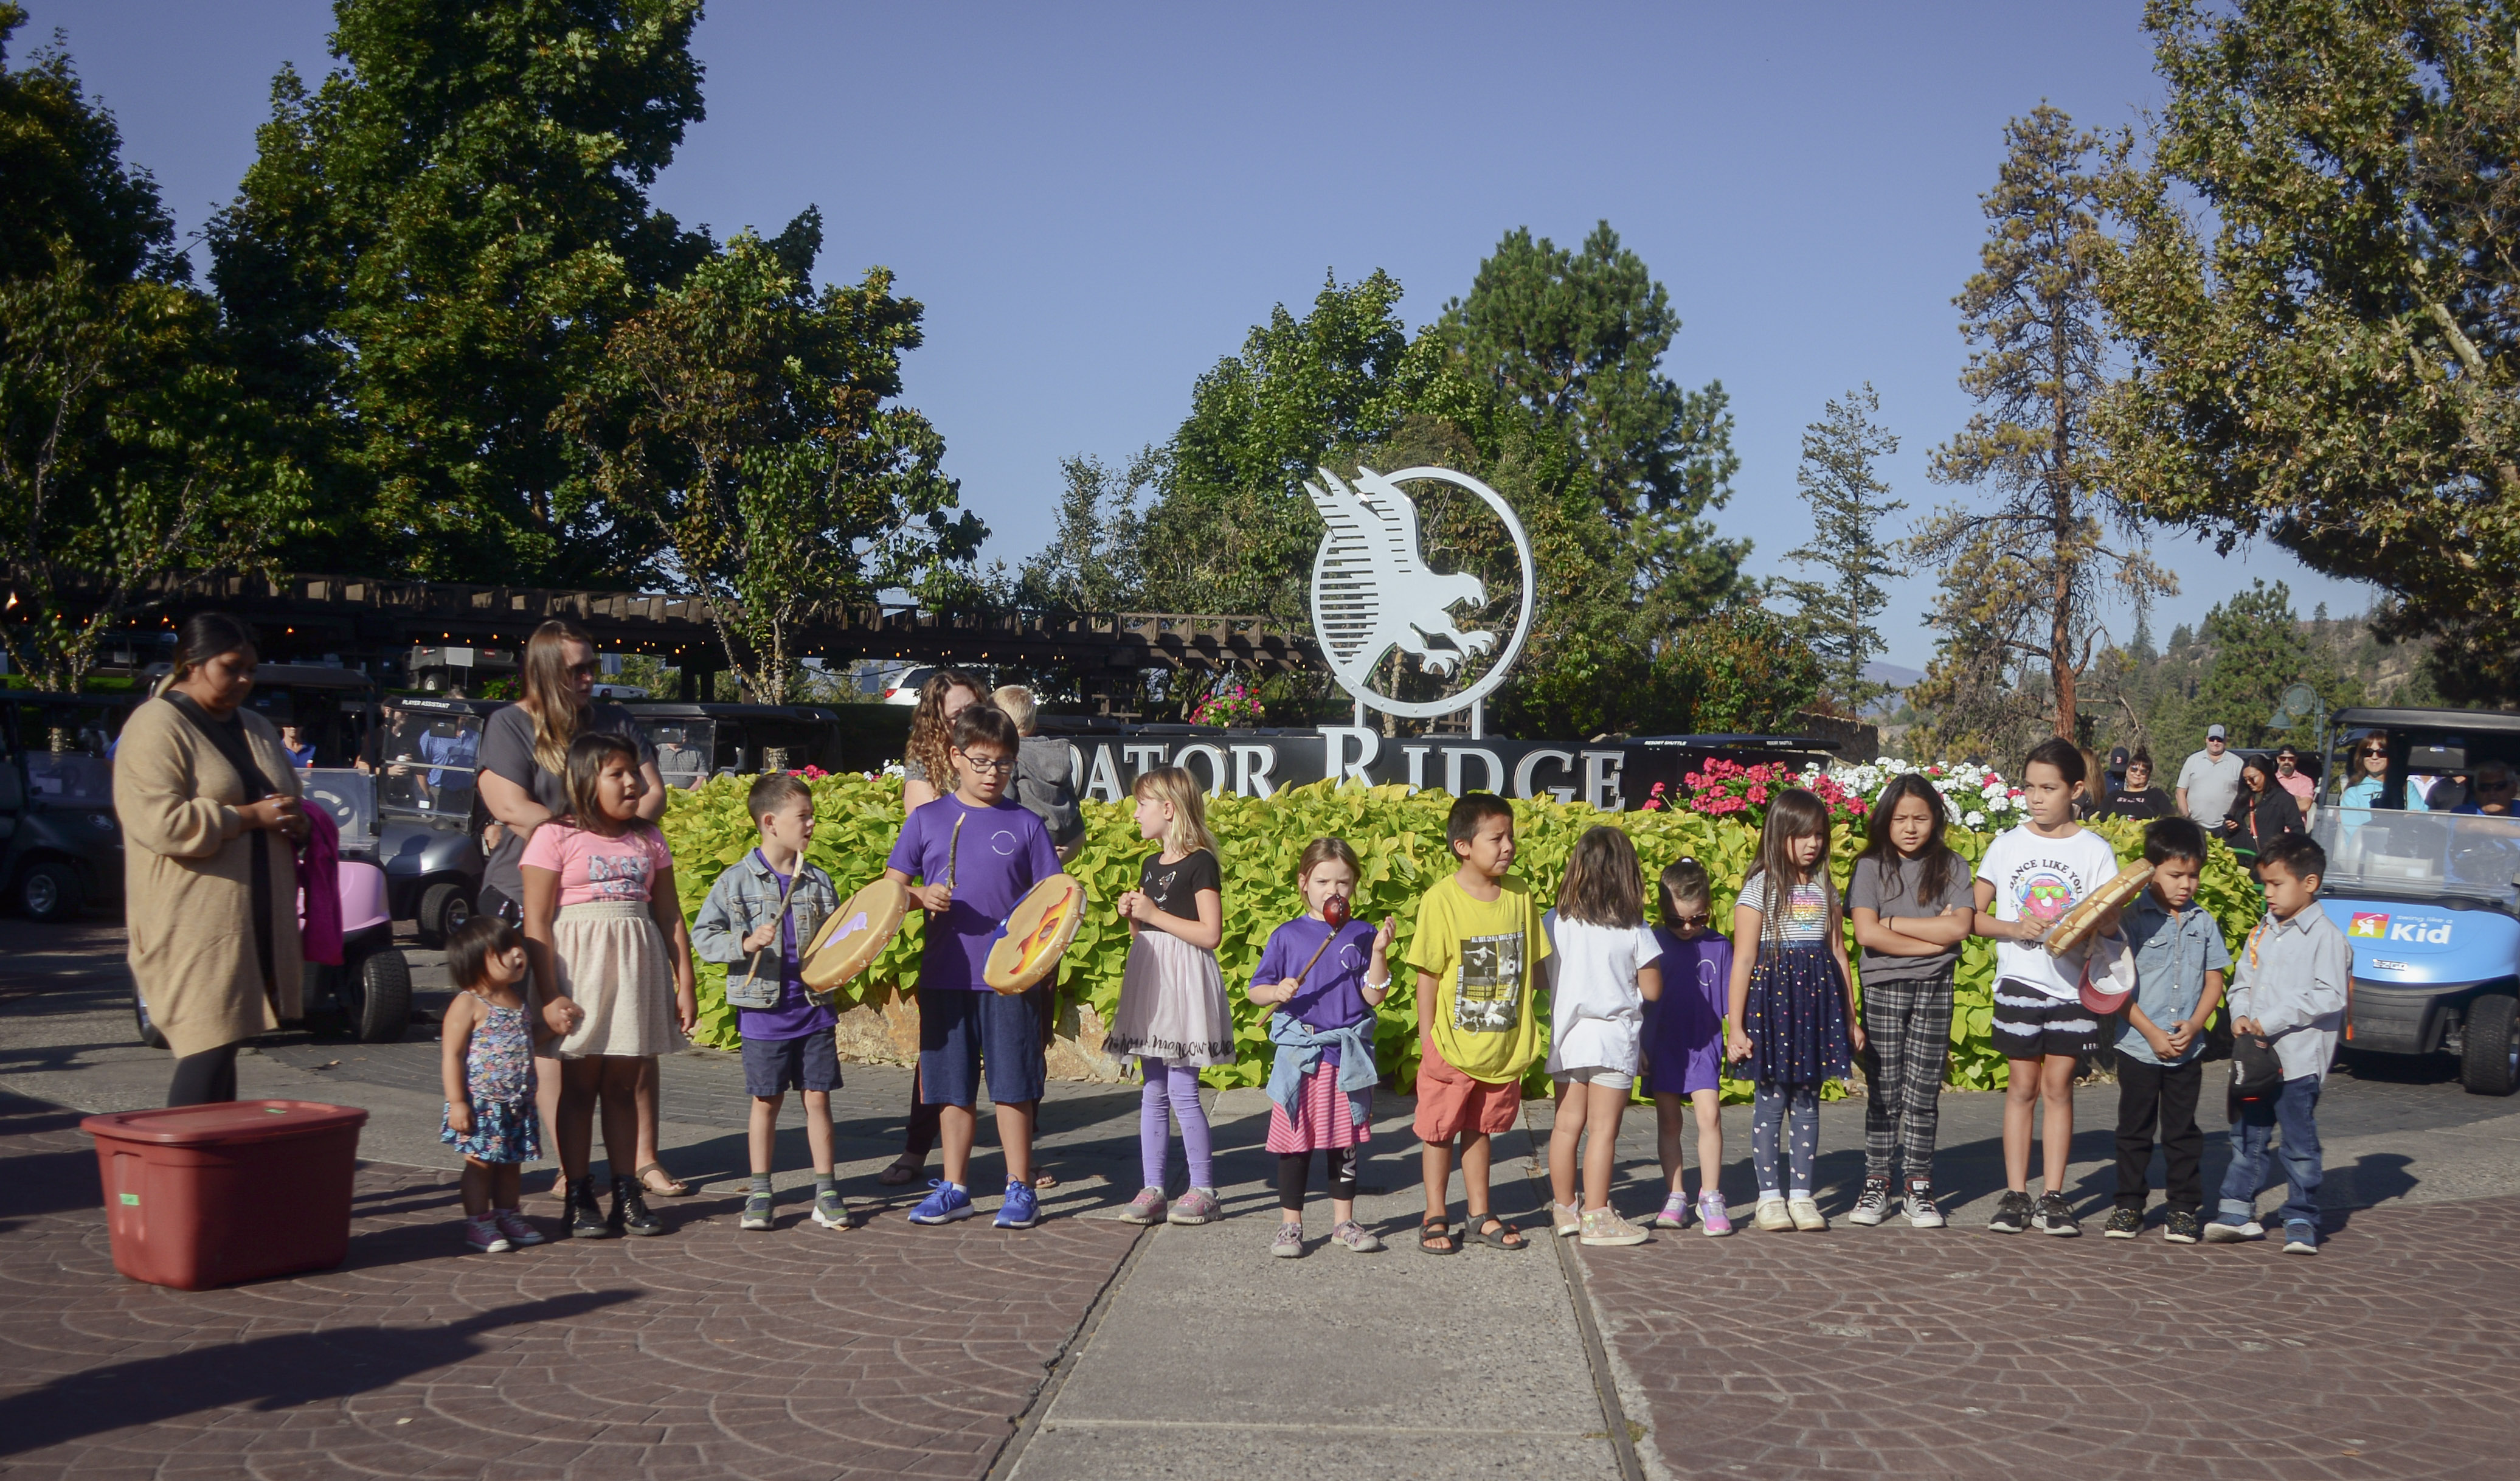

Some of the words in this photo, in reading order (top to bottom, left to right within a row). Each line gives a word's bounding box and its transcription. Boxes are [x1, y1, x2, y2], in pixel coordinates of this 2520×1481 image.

[1317, 724, 1625, 812] RIDGE
[2010, 859, 2037, 890] DANCE
[2042, 859, 2069, 873] LIKE
[2068, 872, 2082, 894] YOU
[2390, 923, 2452, 944] Kid
